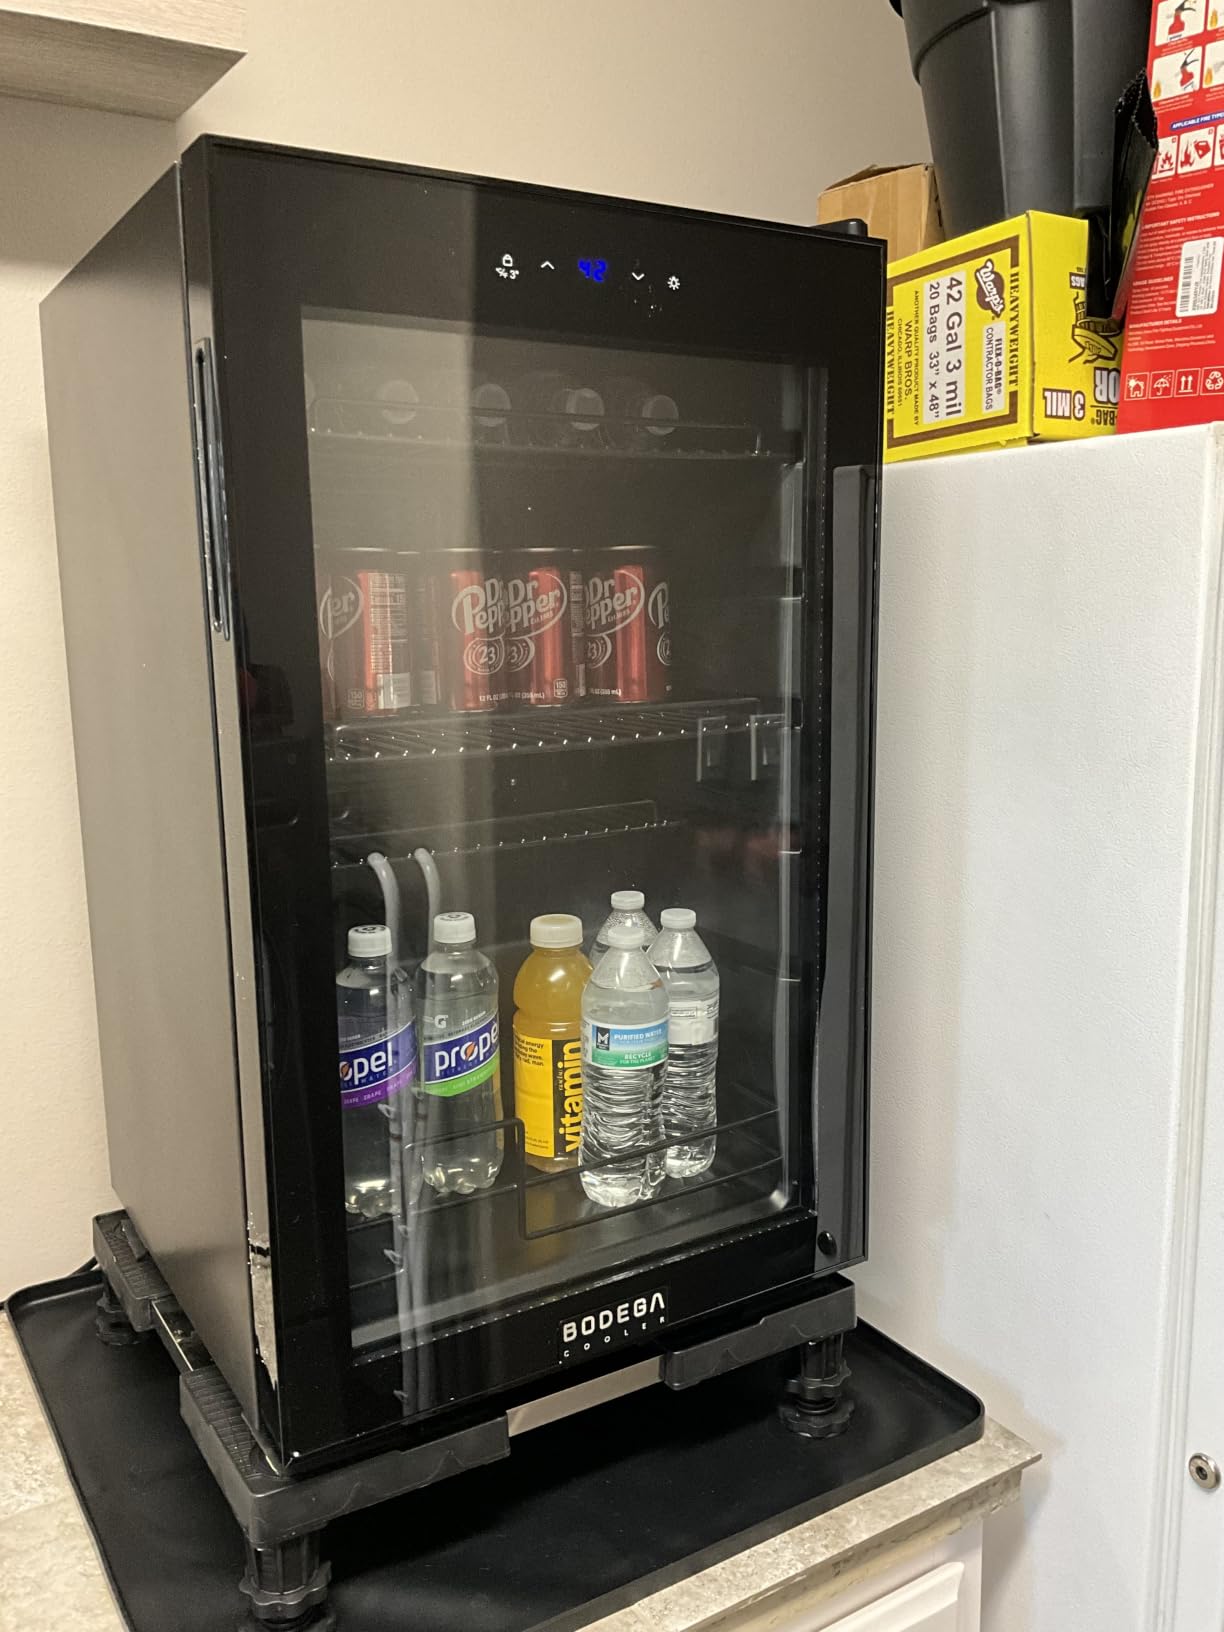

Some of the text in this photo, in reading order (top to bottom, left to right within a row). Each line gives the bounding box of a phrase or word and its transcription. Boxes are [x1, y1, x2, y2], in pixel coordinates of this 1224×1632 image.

[578, 258, 608, 283] 42
[1071, 275, 1086, 286] AGS
[929, 282, 940, 300] 20
[976, 259, 1005, 314] Warp's
[926, 304, 940, 343] Bags
[1008, 272, 1020, 387] HEAVYWEIGHT
[904, 320, 912, 400] WARP BROS.
[946, 278, 962, 416] 42 Gal 3 mil
[985, 327, 994, 410] CONTRACTOR BAGS
[929, 380, 938, 390] x
[1044, 390, 1085, 420] 3 MIL
[508, 579, 538, 608] Dr
[589, 577, 616, 606] Dr
[479, 646, 496, 665] 23
[434, 1022, 498, 1078] prope
[598, 1032, 609, 1044] M
[614, 1033, 644, 1041] PURIFIED
[624, 1052, 652, 1060] RECYCLE
[557, 1038, 584, 1152] vitamin
[562, 1292, 666, 1343] BODEGA
[563, 1316, 666, 1358] COOLER
